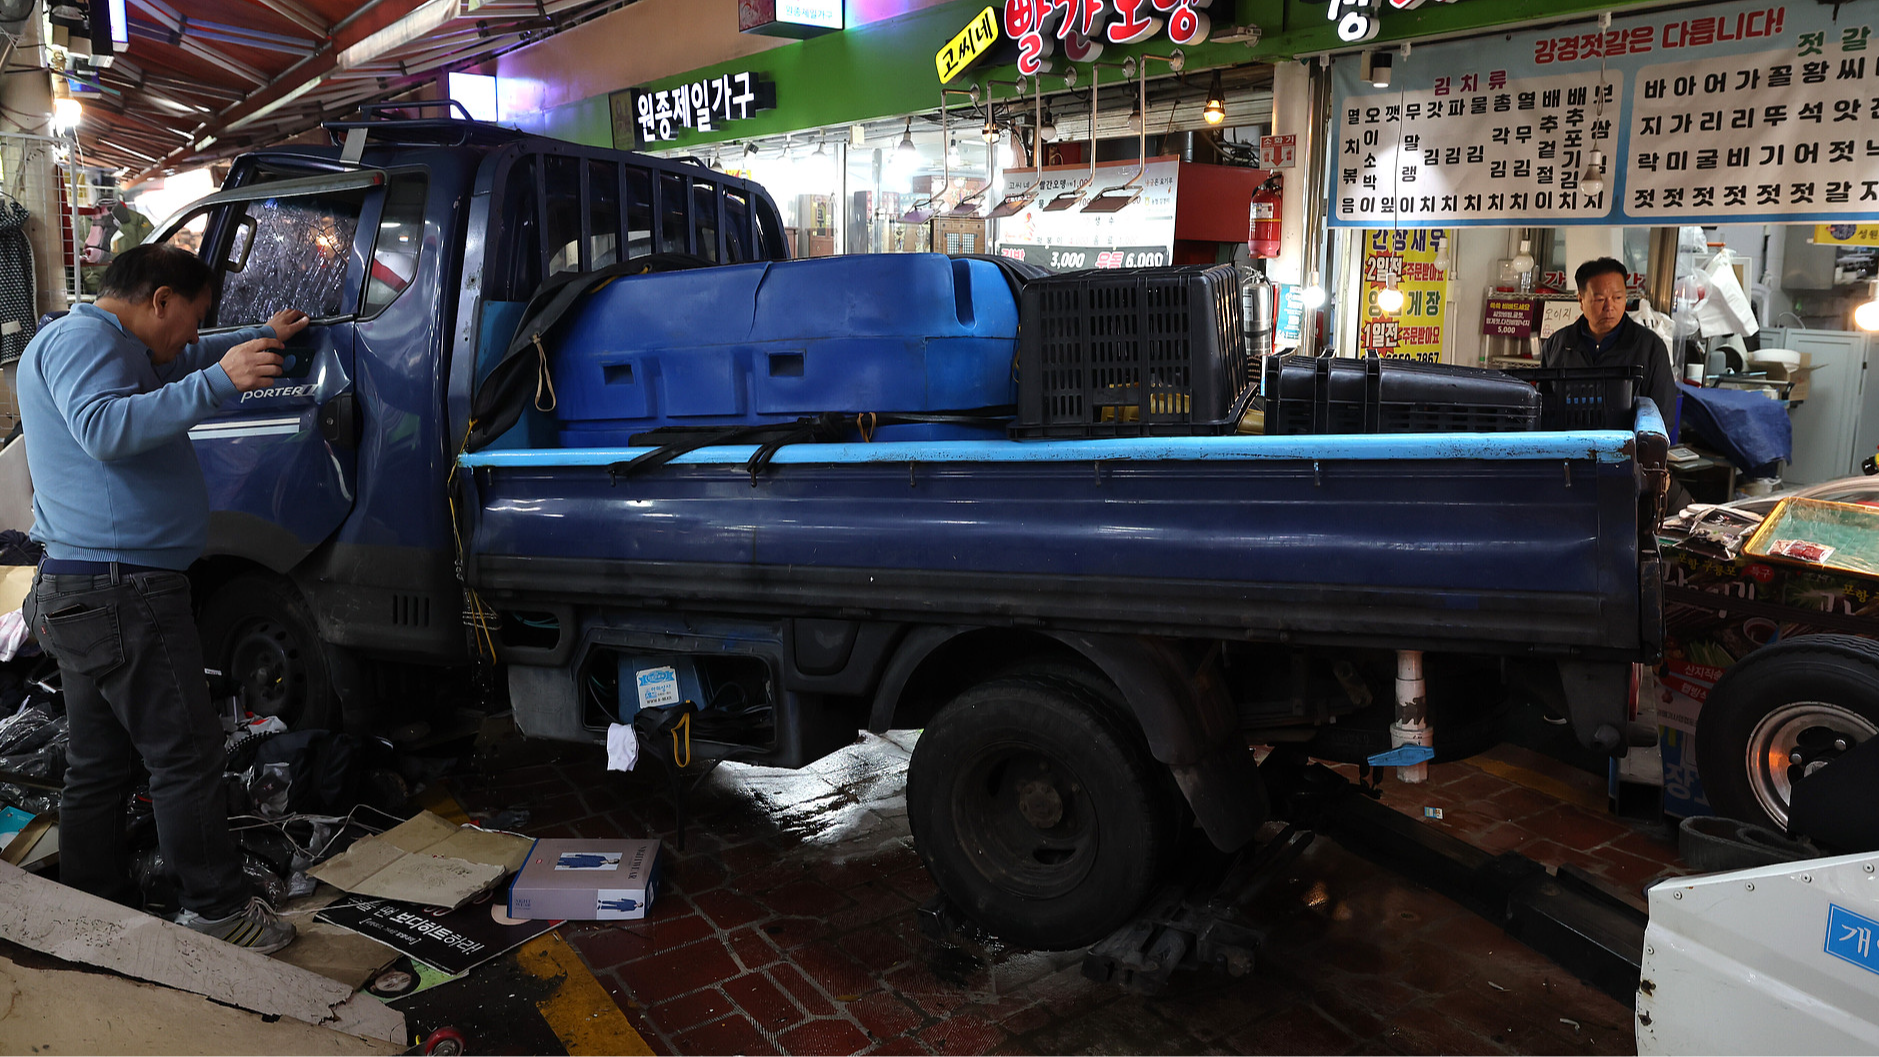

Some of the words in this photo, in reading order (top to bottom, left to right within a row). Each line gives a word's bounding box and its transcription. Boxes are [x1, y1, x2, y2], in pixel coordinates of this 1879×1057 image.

[941, 12, 995, 79] 고씨네
[1533, 26, 1655, 65] 강경젓갈은
[1661, 6, 1786, 49] 다릅니다!
[637, 71, 756, 143] 원종제일가구
[1263, 135, 1295, 145] 소화기
[1050, 251, 1086, 269] 3,000
[1405, 261, 1445, 282] 주문받아요
[1543, 306, 1573, 321] 오이지
[1363, 321, 1400, 349] 1일전
[1401, 325, 1441, 347] 주문받아요
[1497, 325, 1517, 334] 5,000
[240, 386, 304, 404] PORTER
[1838, 923, 1879, 959] 개
